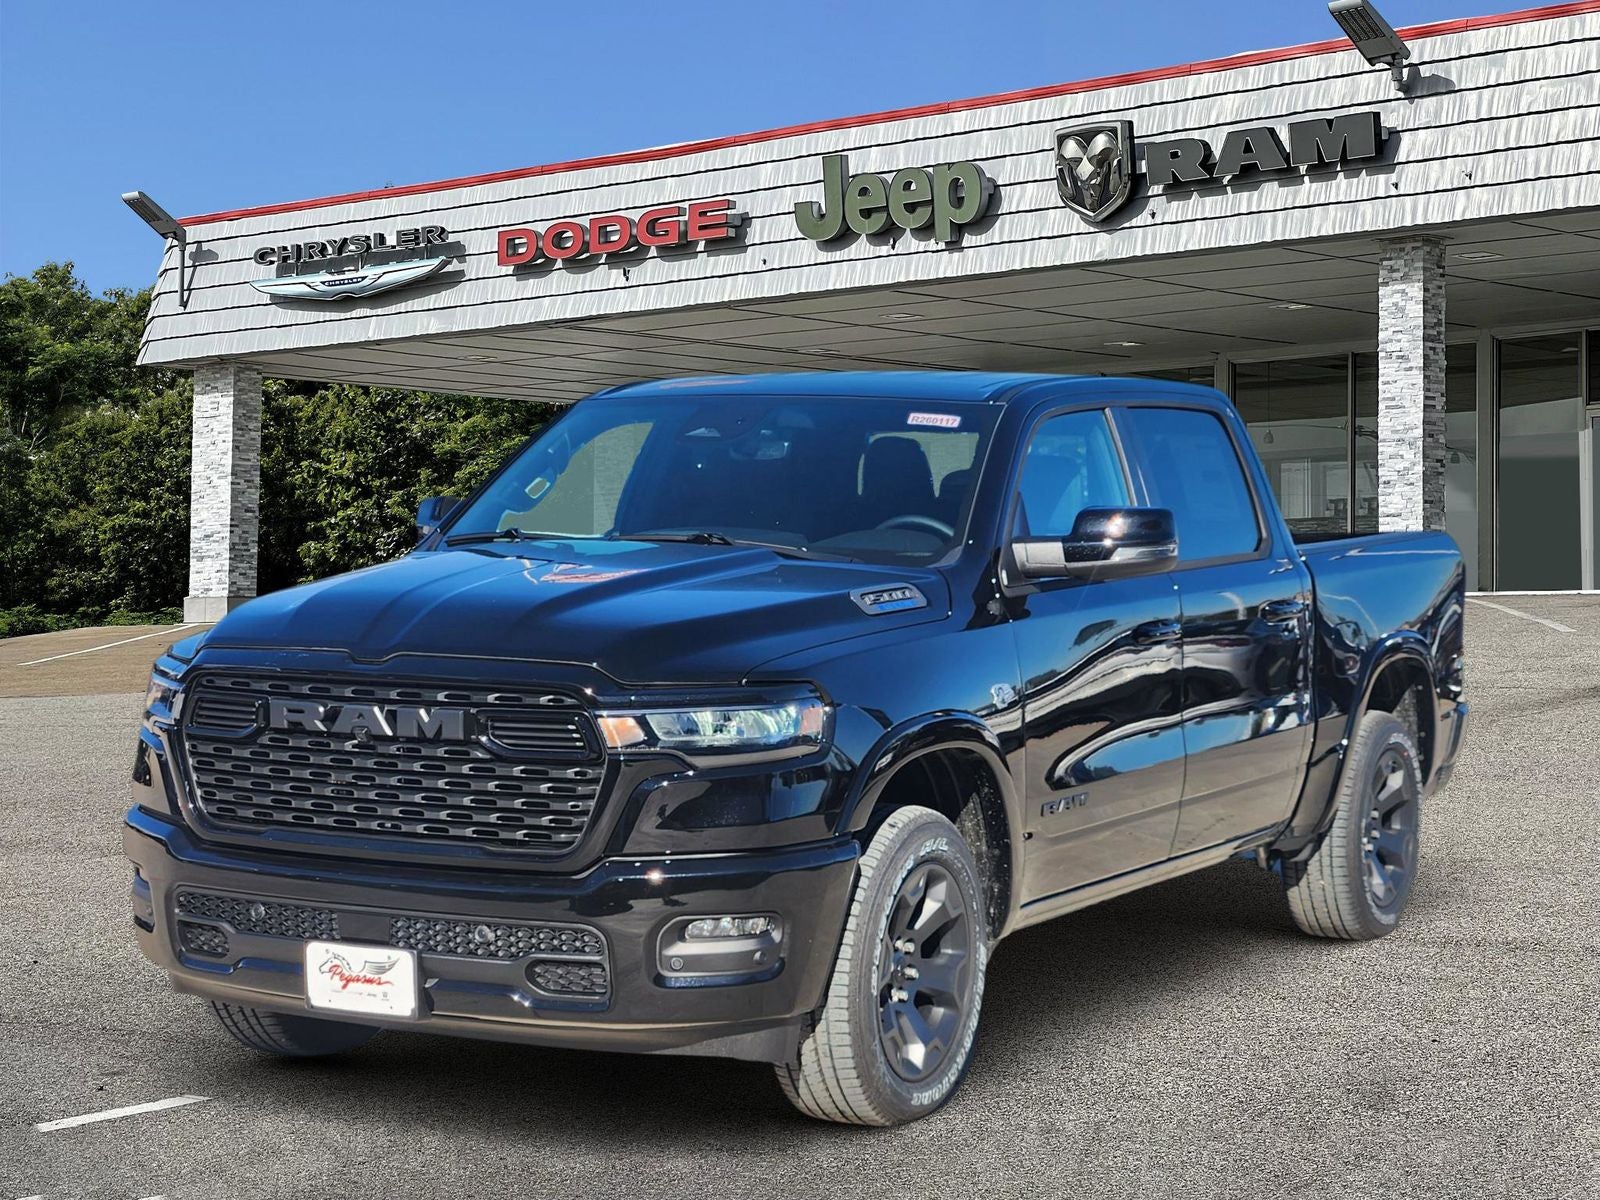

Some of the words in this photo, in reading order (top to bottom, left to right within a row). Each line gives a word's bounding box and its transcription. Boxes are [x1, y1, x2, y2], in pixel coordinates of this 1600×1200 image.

[1145, 111, 1382, 187] RAM
[794, 155, 988, 242] Jeep
[253, 225, 447, 266] CHRYSLER
[497, 199, 736, 267] DODGE
[324, 277, 363, 286] CHRYSLER
[909, 415, 958, 426] R260117
[269, 696, 465, 741] RAM
[329, 964, 394, 990] Pegasus
